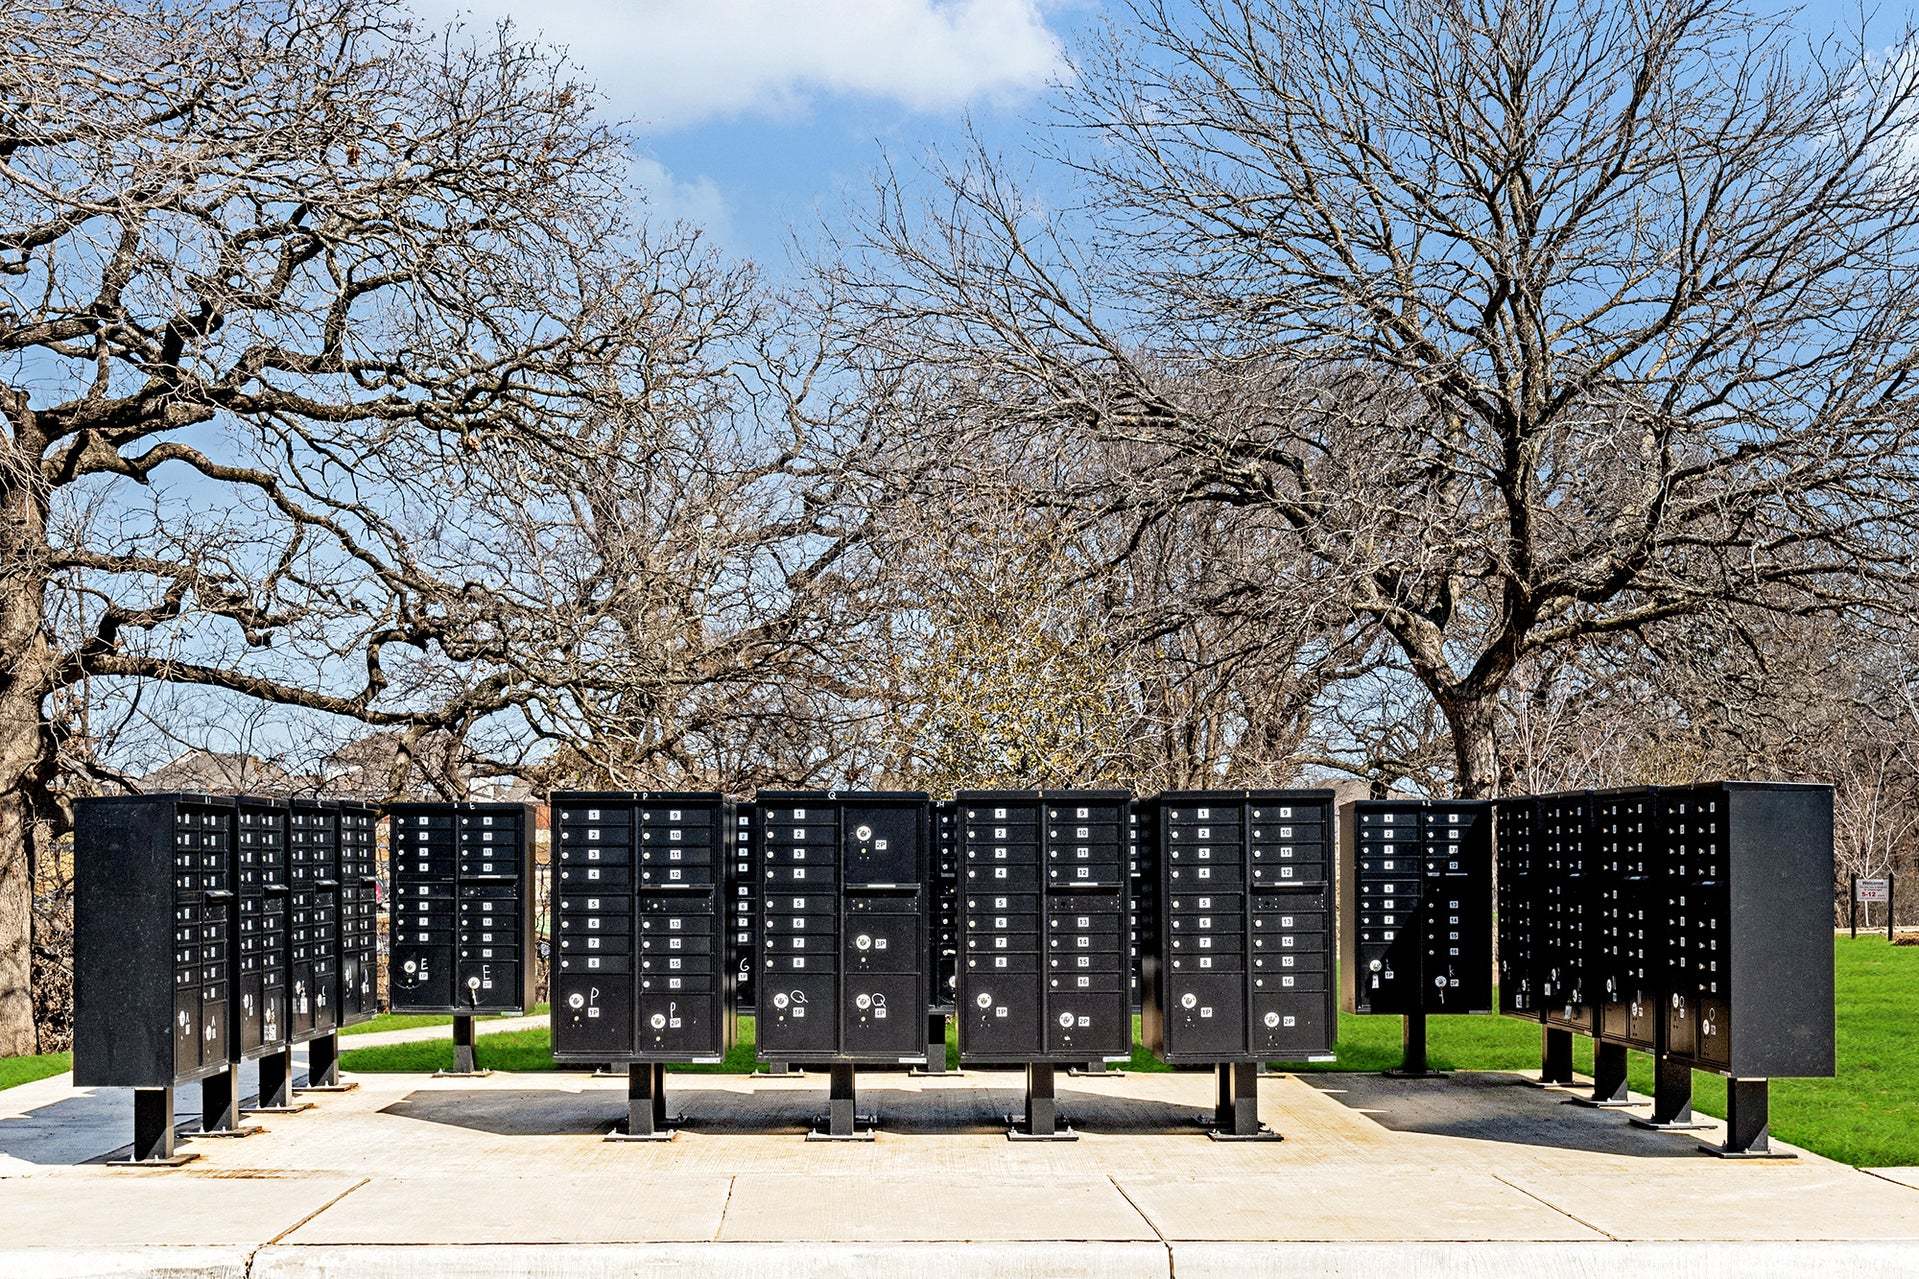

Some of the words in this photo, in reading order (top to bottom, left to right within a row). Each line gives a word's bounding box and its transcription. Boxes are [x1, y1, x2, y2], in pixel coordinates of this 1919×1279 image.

[828, 791, 836, 800] Q
[421, 958, 428, 970] E
[483, 965, 490, 980] E
[590, 987, 599, 1006] P
[790, 990, 808, 1003] Q
[872, 993, 886, 1007] Q
[670, 1002, 676, 1018] P
